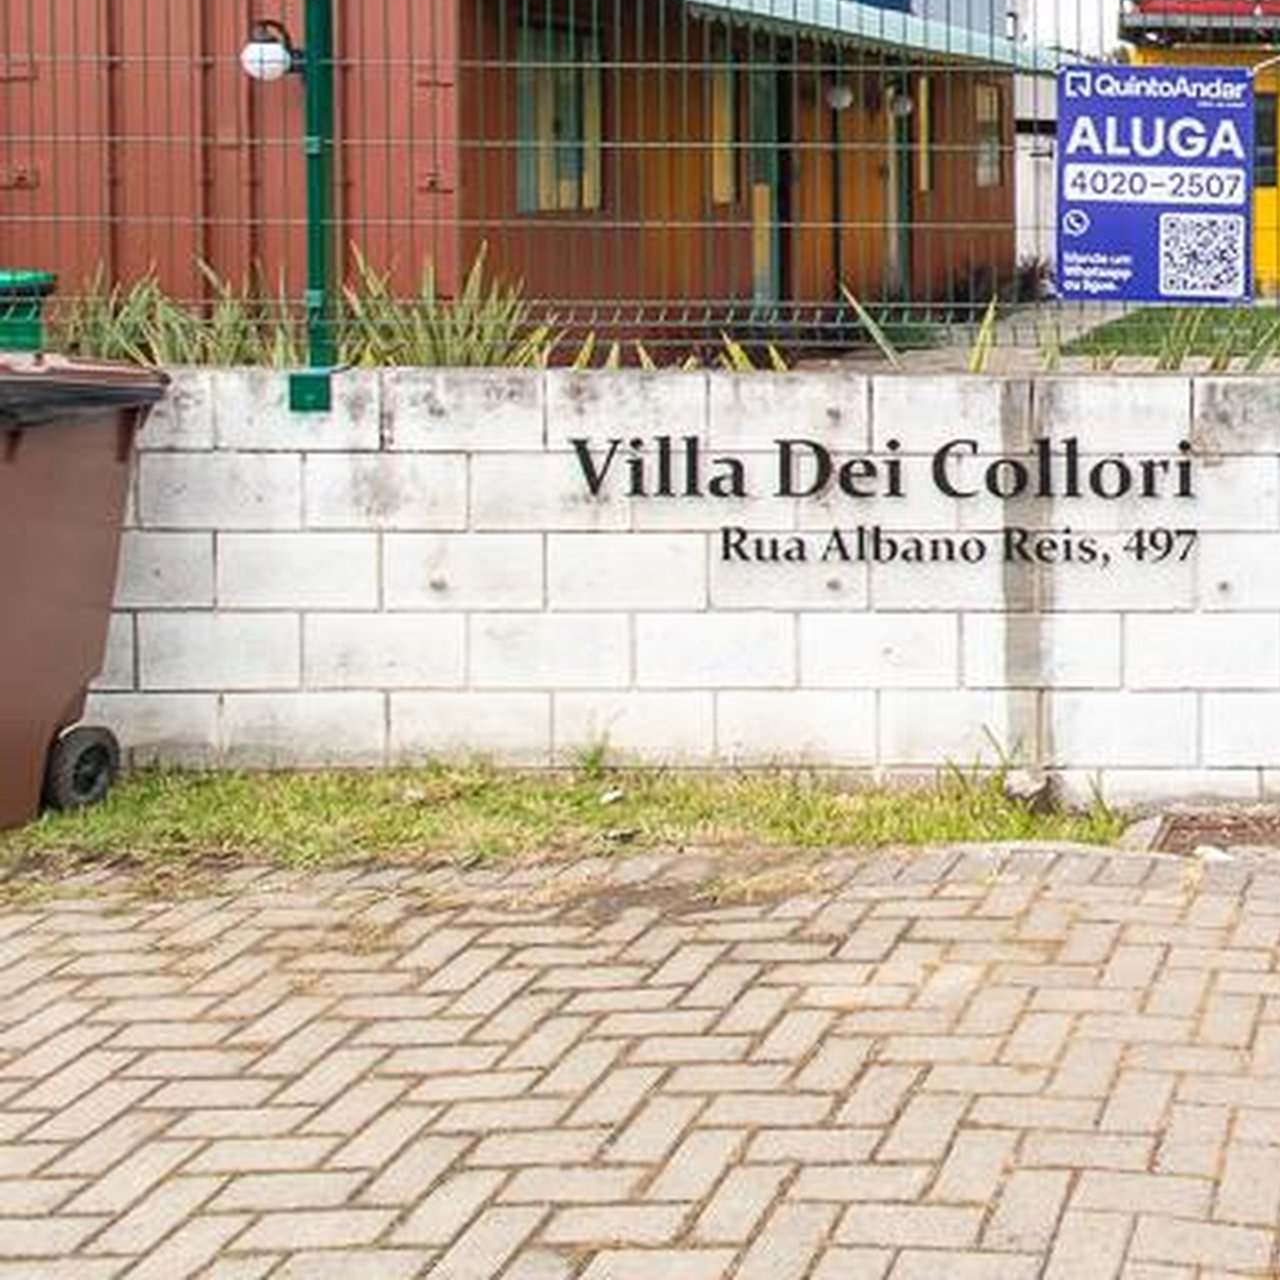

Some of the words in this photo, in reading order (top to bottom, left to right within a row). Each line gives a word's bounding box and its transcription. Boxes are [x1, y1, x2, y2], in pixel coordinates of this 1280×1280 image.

[1095, 74, 1247, 100] QuintoAndar
[1065, 115, 1246, 159] ALUGA
[1070, 171, 1242, 199] 4020-2507
[568, 435, 746, 500] Villa
[773, 436, 906, 500] Dei
[931, 436, 1195, 500] Collori
[720, 527, 807, 563] Rua
[821, 526, 986, 564] Albano
[1003, 526, 1111, 568] Reis,
[1123, 527, 1199, 564] 497
